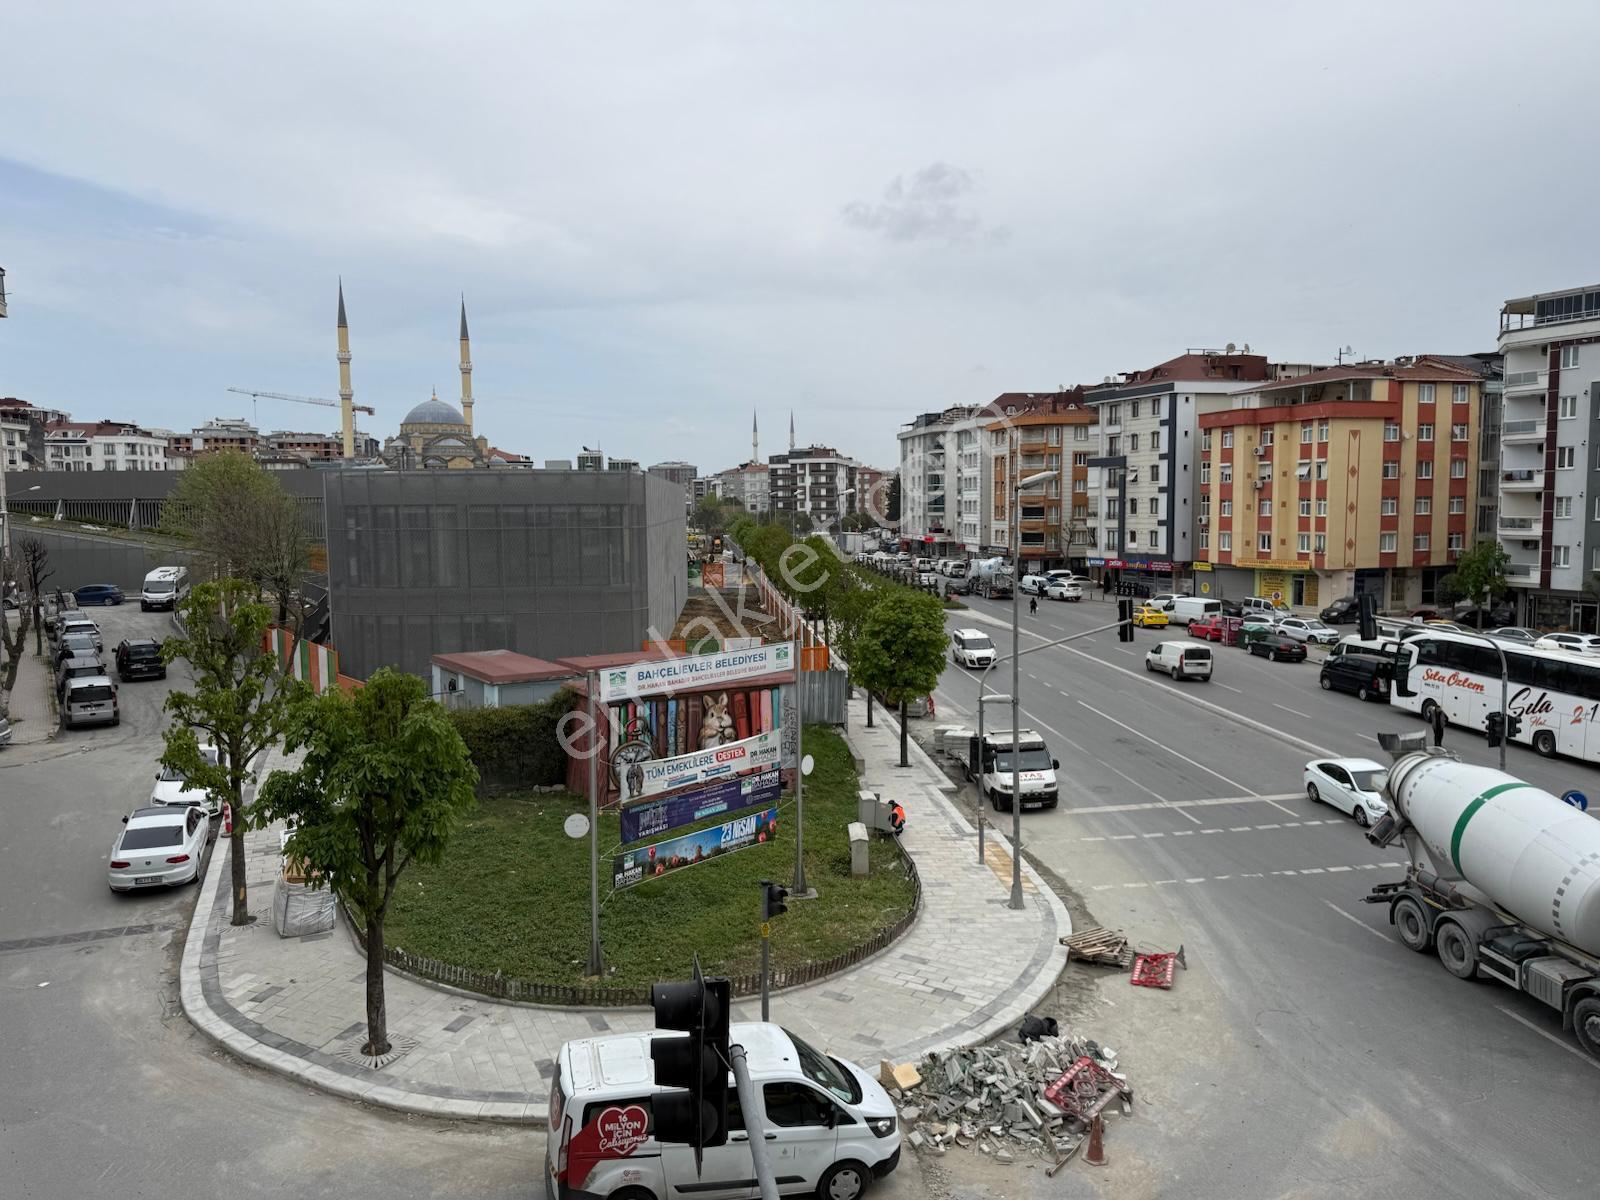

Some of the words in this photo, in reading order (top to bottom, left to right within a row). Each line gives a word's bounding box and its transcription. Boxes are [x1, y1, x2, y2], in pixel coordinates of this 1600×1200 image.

[637, 661, 713, 681] BAHÇELİEVLER
[715, 652, 767, 669] BELEDİYESİ
[1447, 671, 1485, 692] Özlem
[1508, 687, 1554, 717] Sıla
[646, 765, 666, 780] TÜM
[667, 753, 714, 775] EMEKLİLERE
[717, 747, 744, 761] DESTEK
[638, 823, 669, 838] YARIŞMASI
[721, 824, 732, 843] 23
[732, 816, 757, 840] NİSAN
[604, 1121, 641, 1132] MİLYON
[618, 1114, 628, 1123] 16
